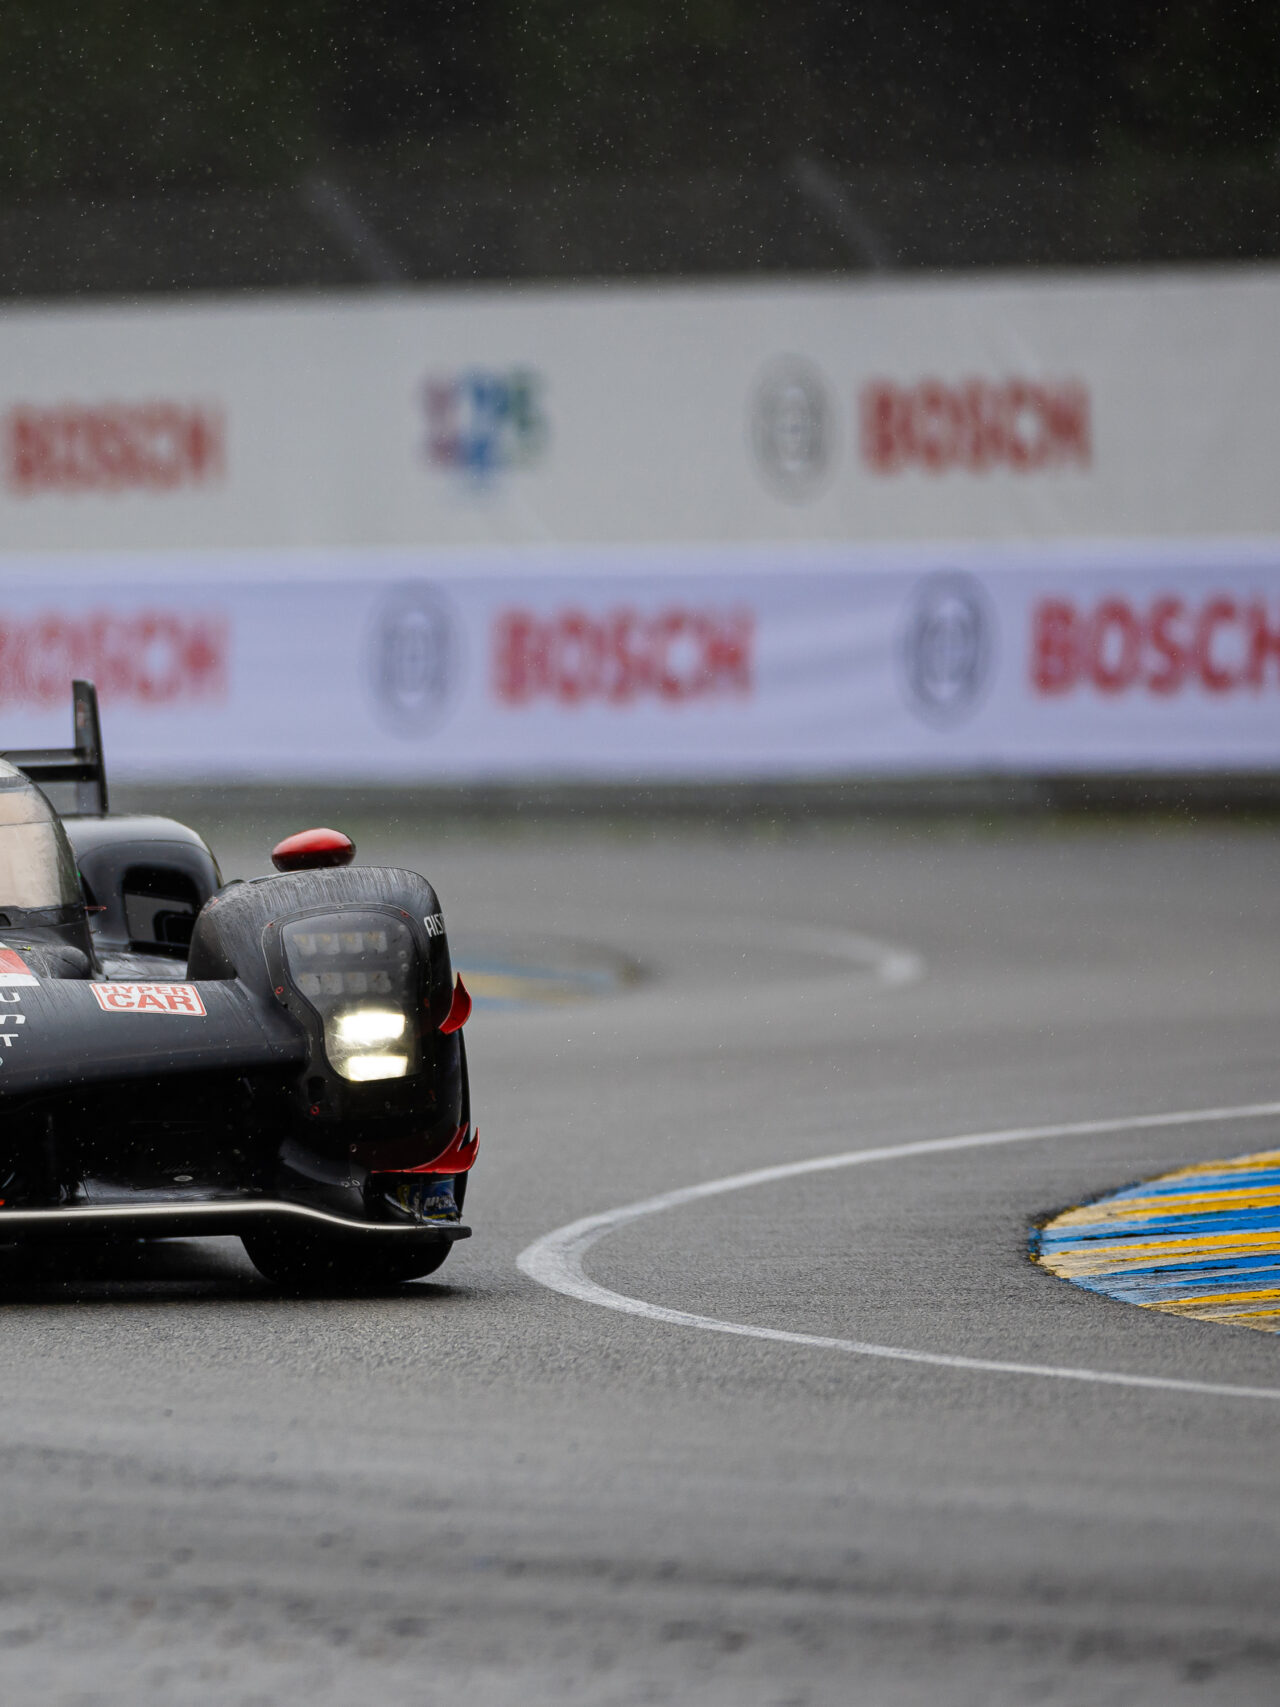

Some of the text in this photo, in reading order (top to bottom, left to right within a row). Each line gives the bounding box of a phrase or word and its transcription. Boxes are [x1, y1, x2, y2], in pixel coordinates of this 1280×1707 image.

[860, 378, 1090, 476] BOSCH
[492, 608, 754, 707] BOSCH
[100, 985, 189, 996] HYPER
[106, 993, 197, 1012] CAR
